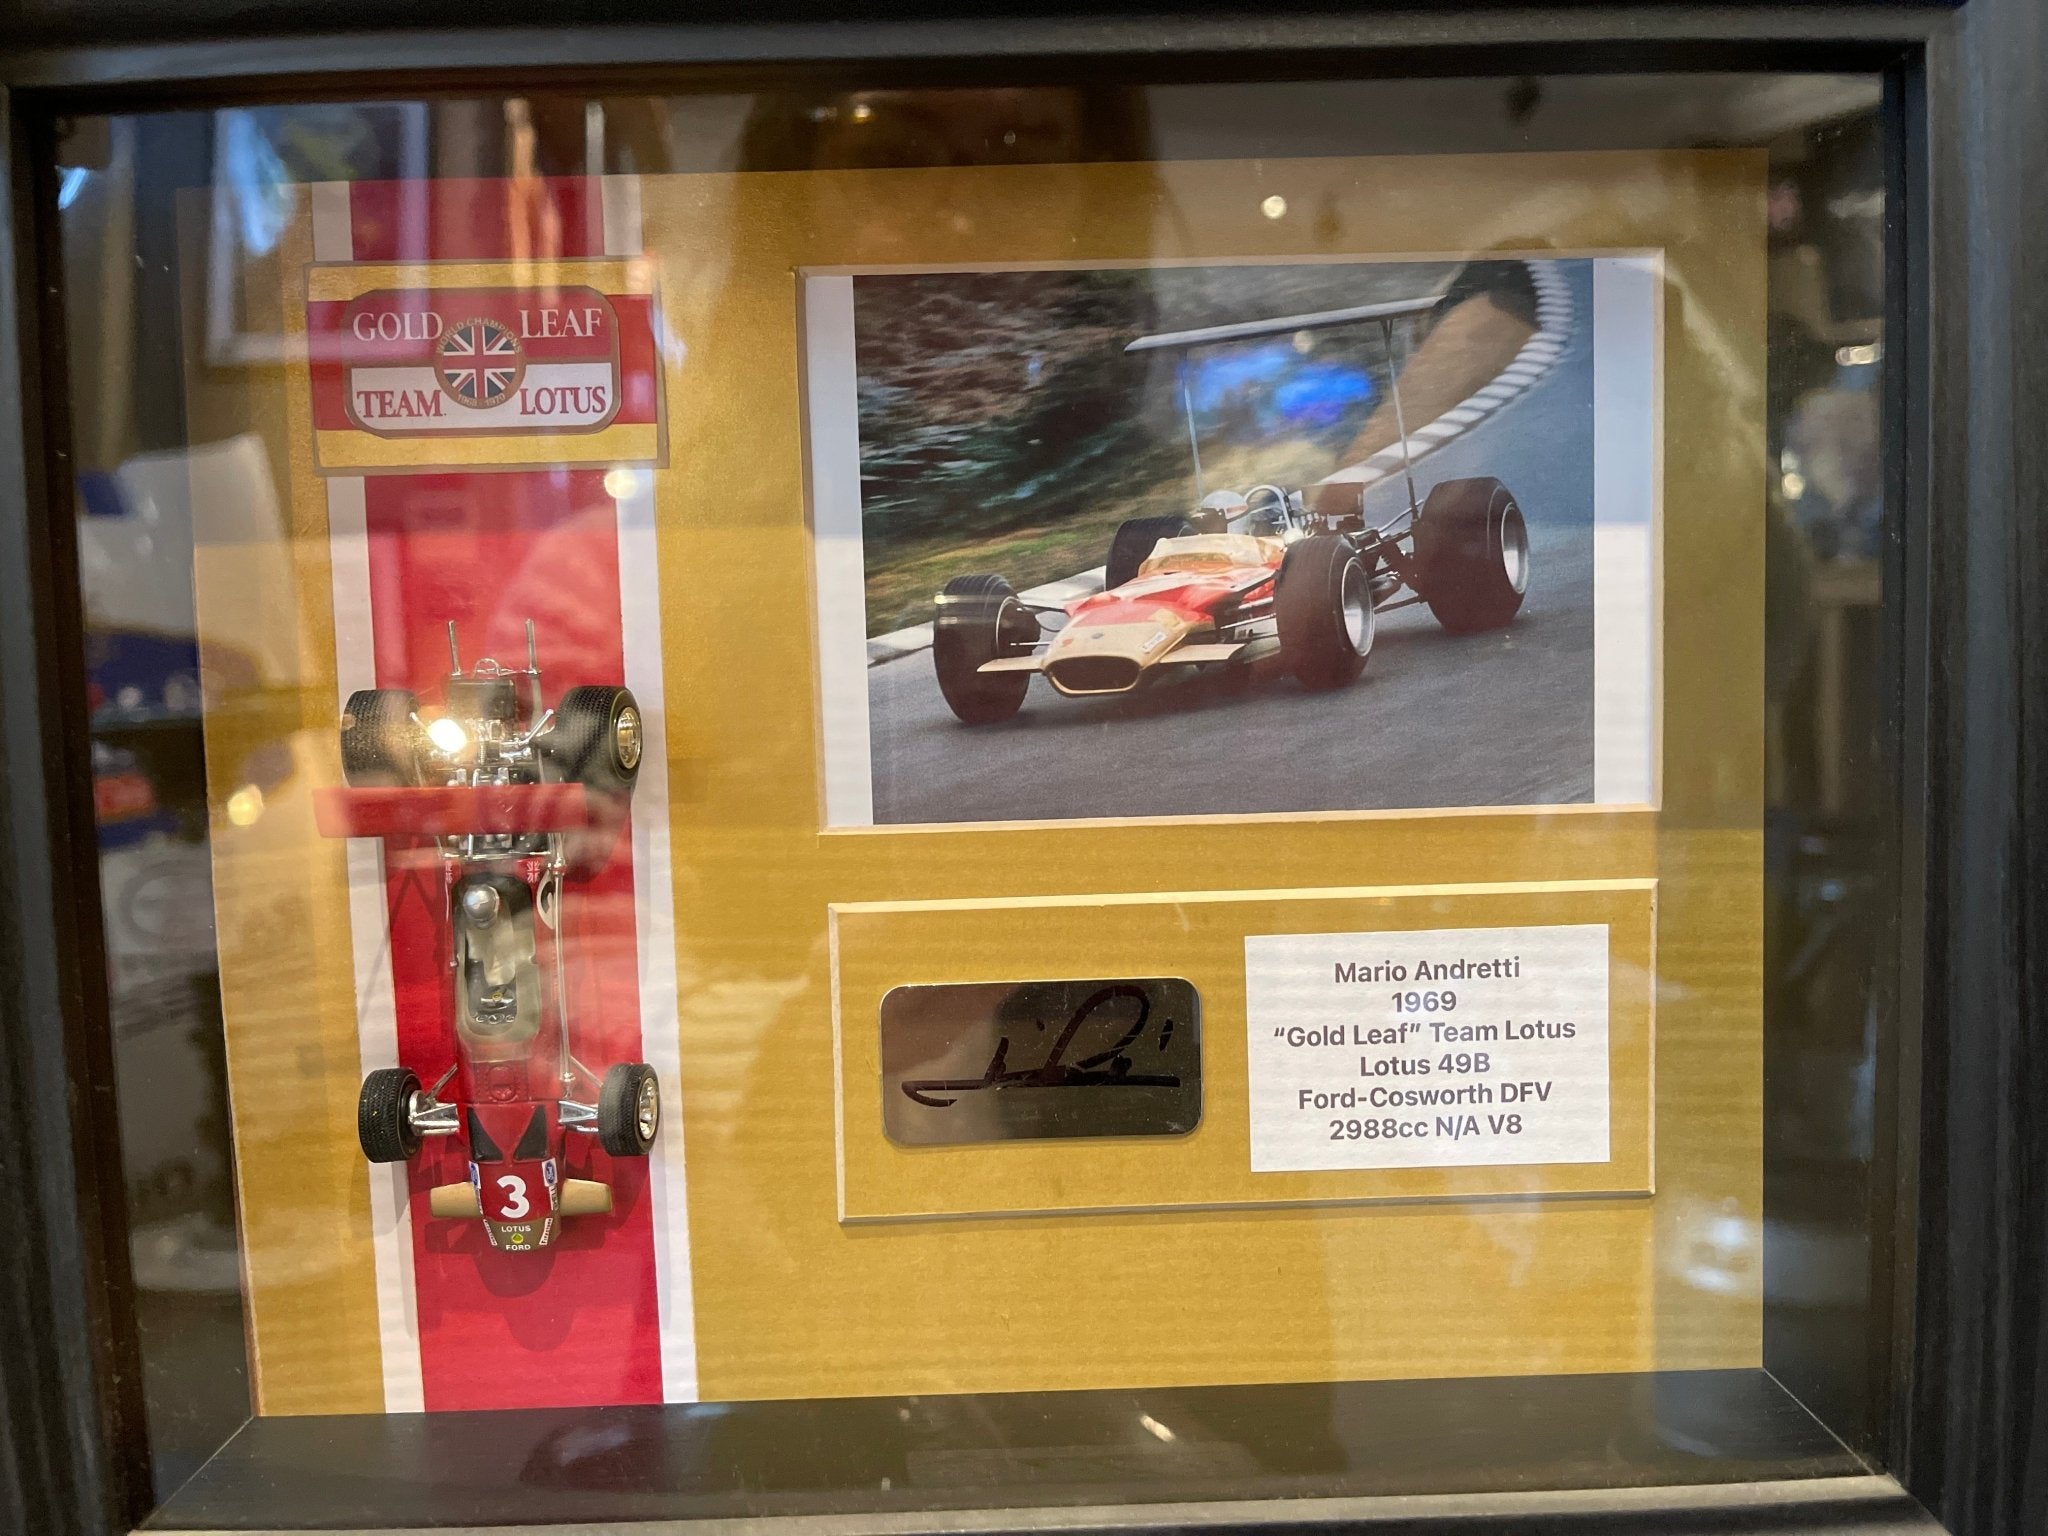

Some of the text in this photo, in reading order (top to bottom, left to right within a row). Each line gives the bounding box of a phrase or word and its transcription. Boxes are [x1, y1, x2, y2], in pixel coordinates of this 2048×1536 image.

[353, 308, 602, 342] GOLD LEAF
[466, 317, 522, 354] CHAMPIONS
[357, 386, 606, 417] TEAM LOTUS
[1335, 955, 1520, 984] Mario Andretti
[1391, 991, 1457, 1013] 1969
[1273, 1020, 1576, 1048] “Gold Leaf” Team Lotus
[1360, 1052, 1491, 1077] Lotus 49B
[1299, 1081, 1552, 1110] Ford-Cosworth DFV
[1329, 1114, 1523, 1141] 2988cc N/A V8
[496, 1175, 530, 1218] 3
